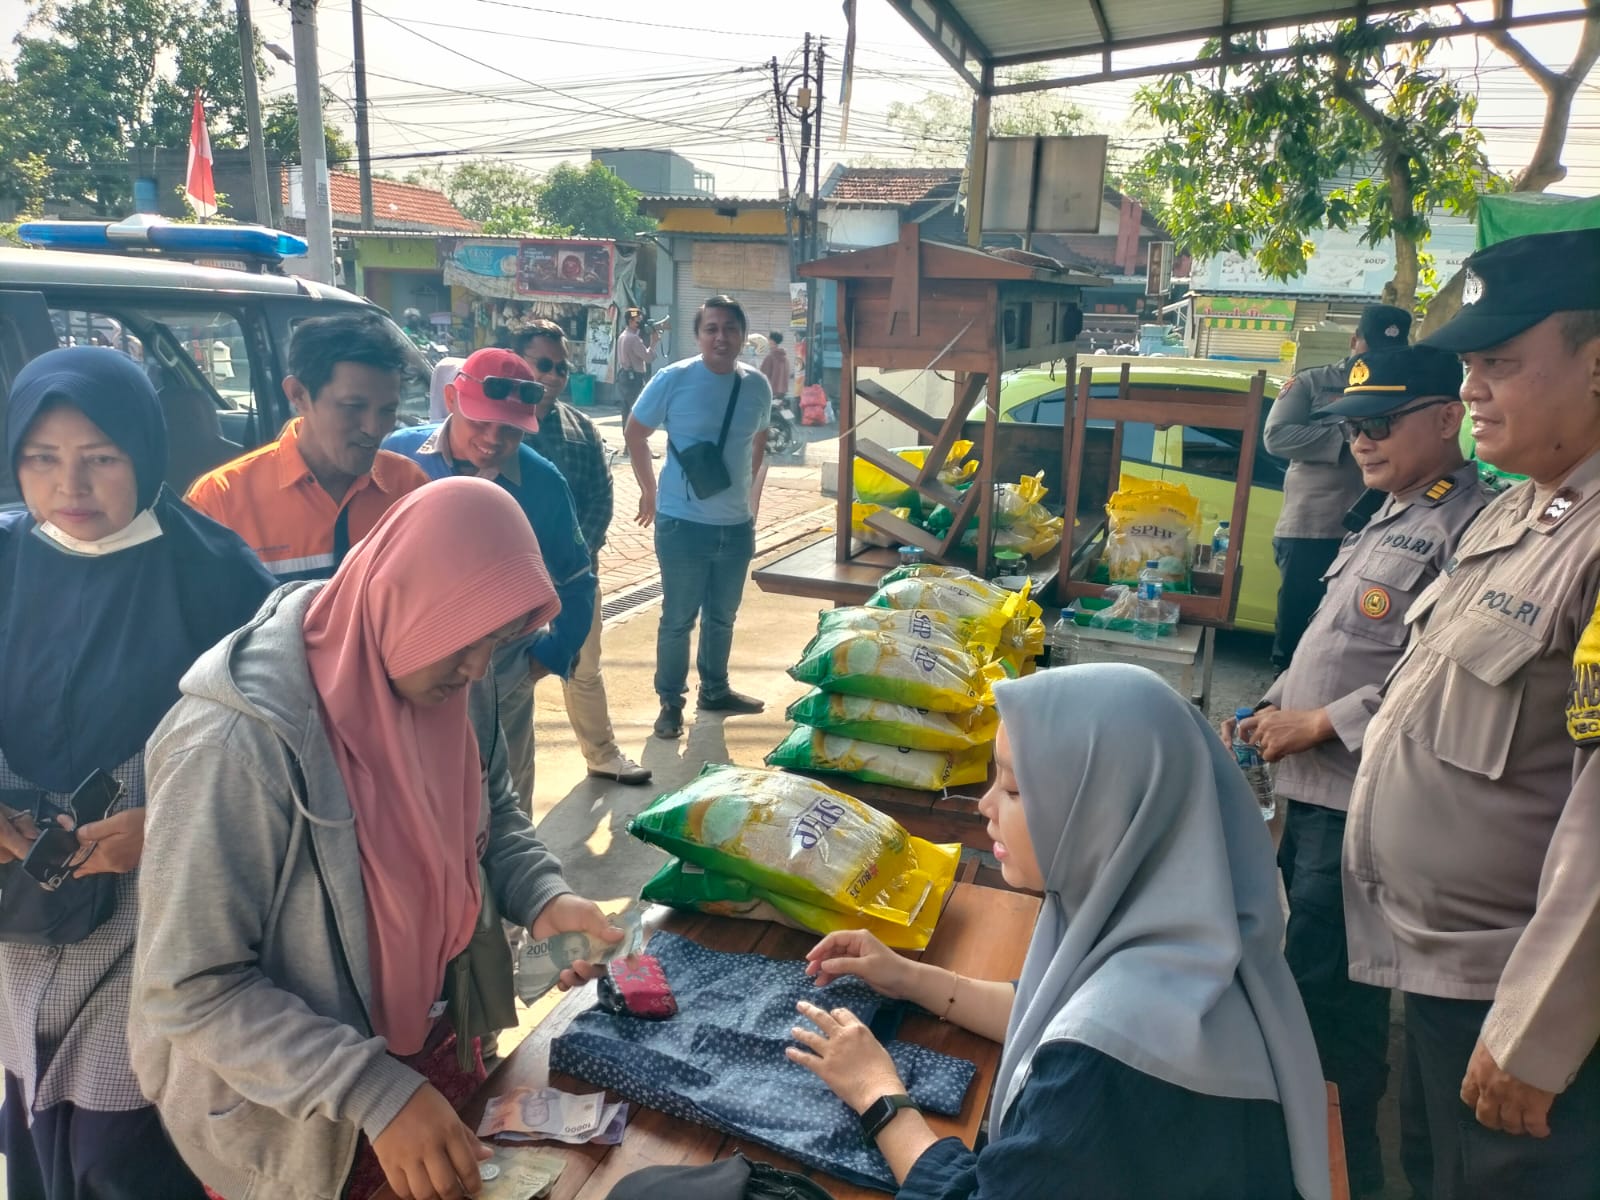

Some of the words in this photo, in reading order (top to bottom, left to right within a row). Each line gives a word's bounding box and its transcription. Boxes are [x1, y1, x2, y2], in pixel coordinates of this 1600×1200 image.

[1382, 535, 1434, 555] POLRI
[1478, 590, 1541, 626] POLRI
[793, 799, 846, 850] SPHP
